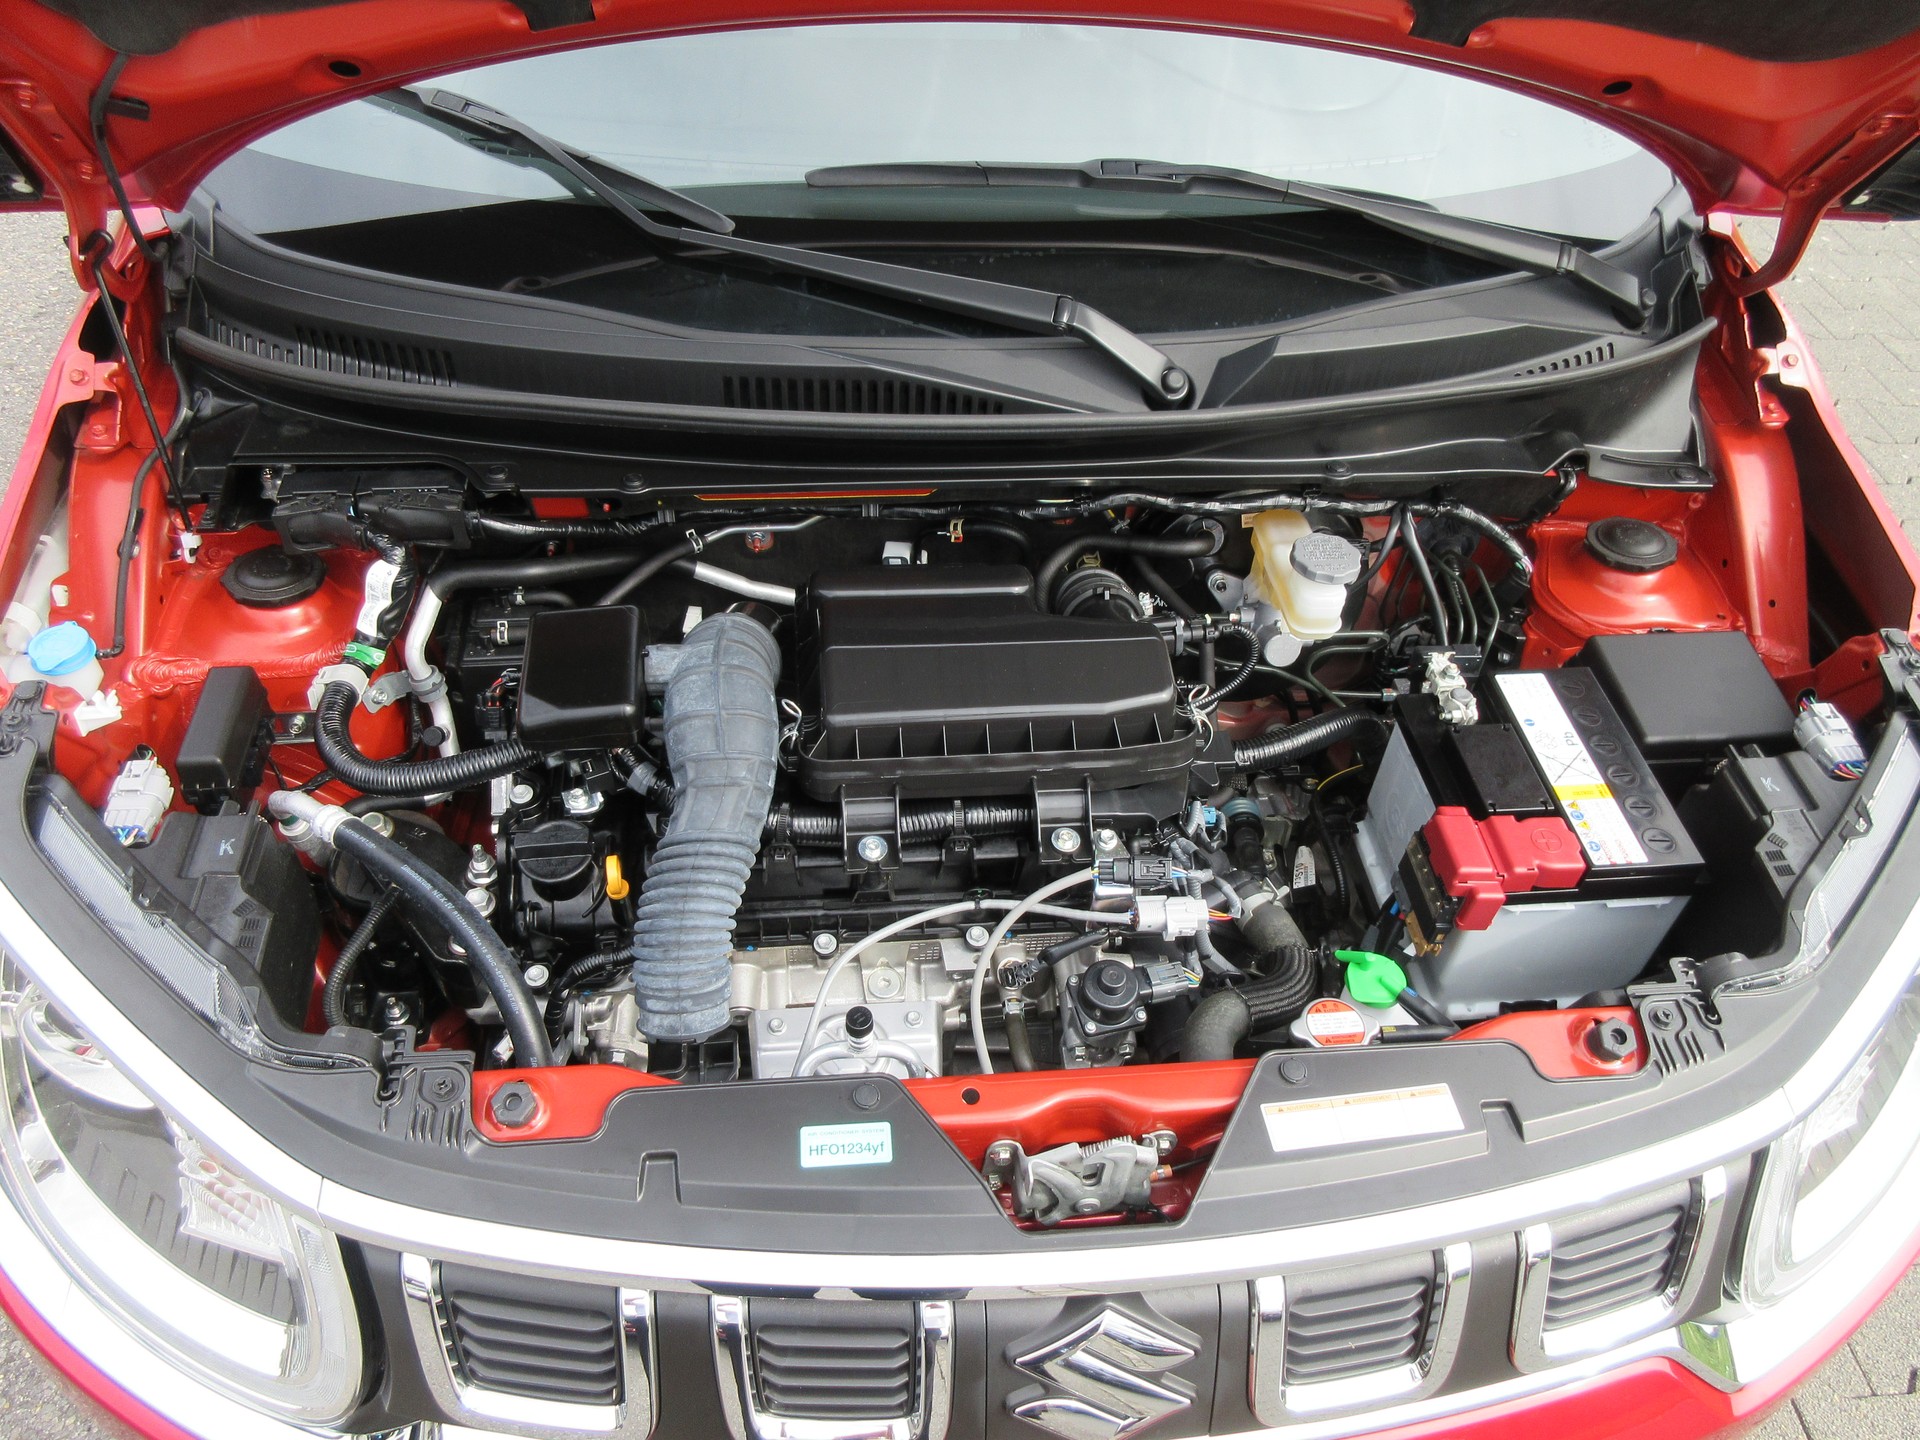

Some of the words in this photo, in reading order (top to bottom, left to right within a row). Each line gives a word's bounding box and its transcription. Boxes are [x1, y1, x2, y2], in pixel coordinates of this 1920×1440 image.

[1760, 776, 1780, 792] K
[219, 838, 236, 856] K
[432, 889, 455, 910] NEX-IV
[819, 1129, 859, 1137] CONDITIONER
[809, 1141, 885, 1157] HFO1234yf
